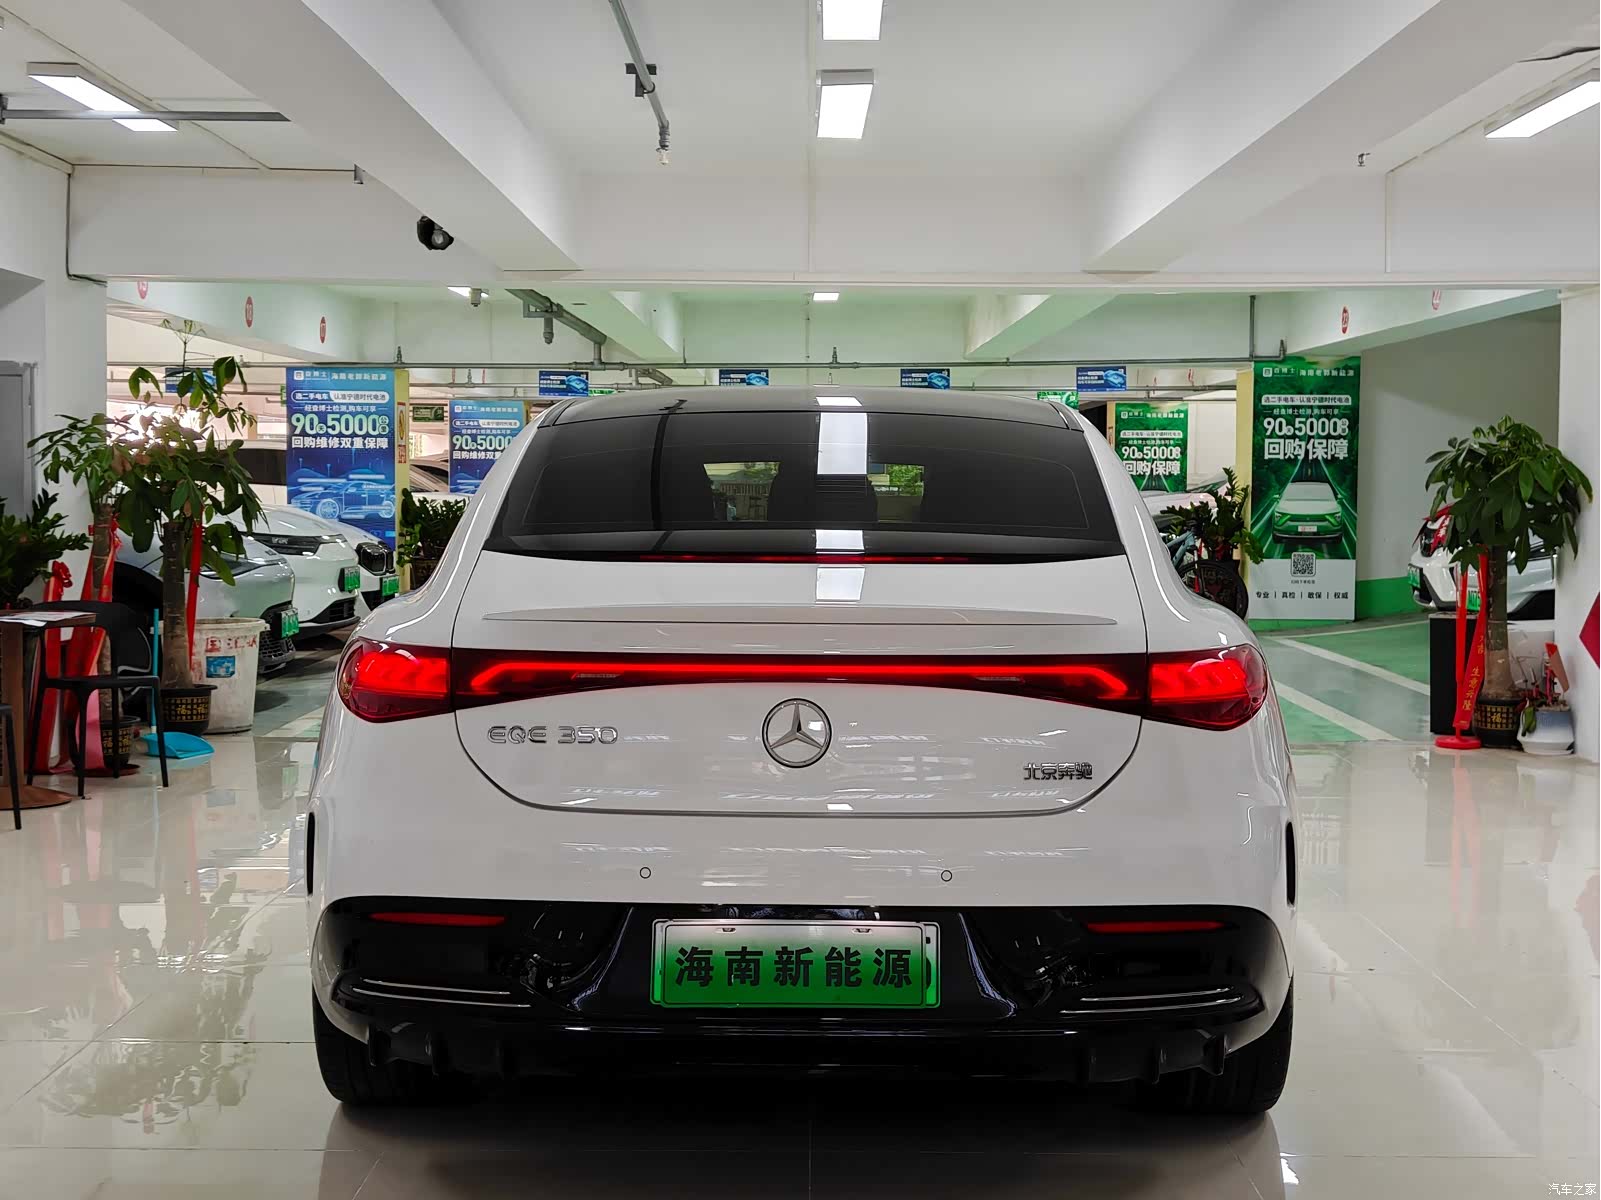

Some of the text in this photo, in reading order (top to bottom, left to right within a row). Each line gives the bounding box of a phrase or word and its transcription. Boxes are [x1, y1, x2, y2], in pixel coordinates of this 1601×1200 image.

[291, 436, 388, 449] 回购维修双重保障
[1264, 438, 1348, 460] 回购保障
[1123, 460, 1181, 476] 回购保障
[488, 725, 618, 744] EQE 350
[1024, 762, 1092, 780] 北京奔驰
[675, 946, 912, 988] 海南新能源
